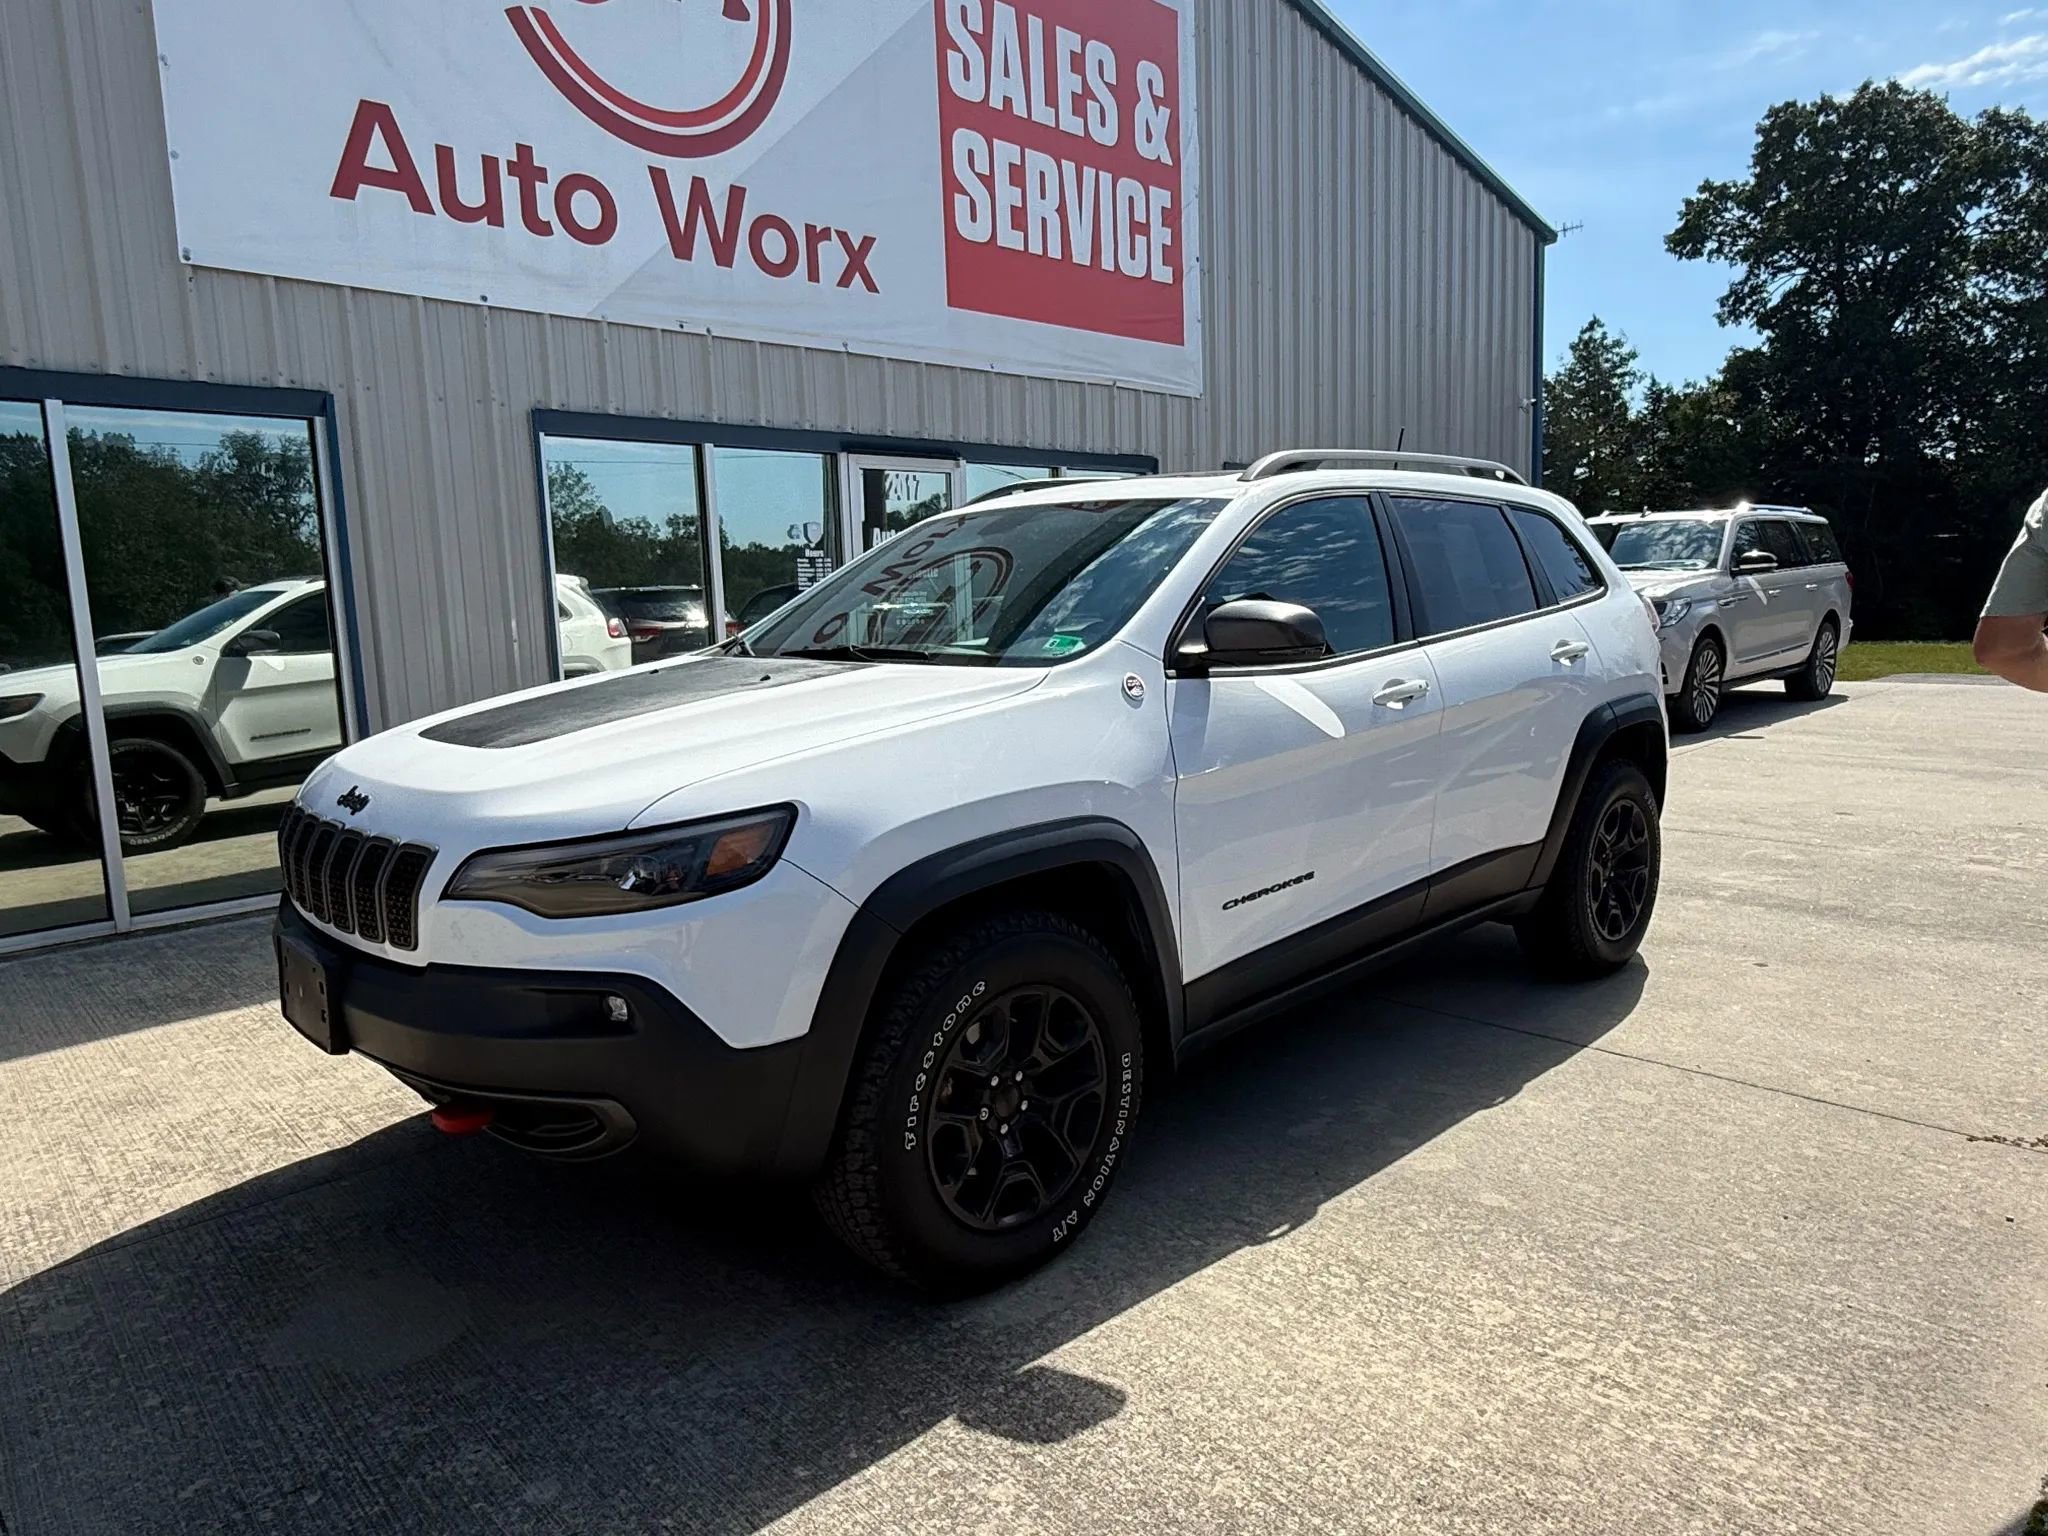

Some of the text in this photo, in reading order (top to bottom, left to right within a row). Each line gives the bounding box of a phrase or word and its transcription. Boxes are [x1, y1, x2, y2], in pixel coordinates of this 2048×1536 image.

[944, 0, 1174, 167] SALES &
[329, 98, 881, 294] Auto Worx
[951, 127, 1174, 285] SERVICE
[1222, 870, 1316, 910] CHEROKEE
[904, 980, 986, 1150] FIRESTONE
[1052, 1052, 1132, 1242] DESTINATION A/T
